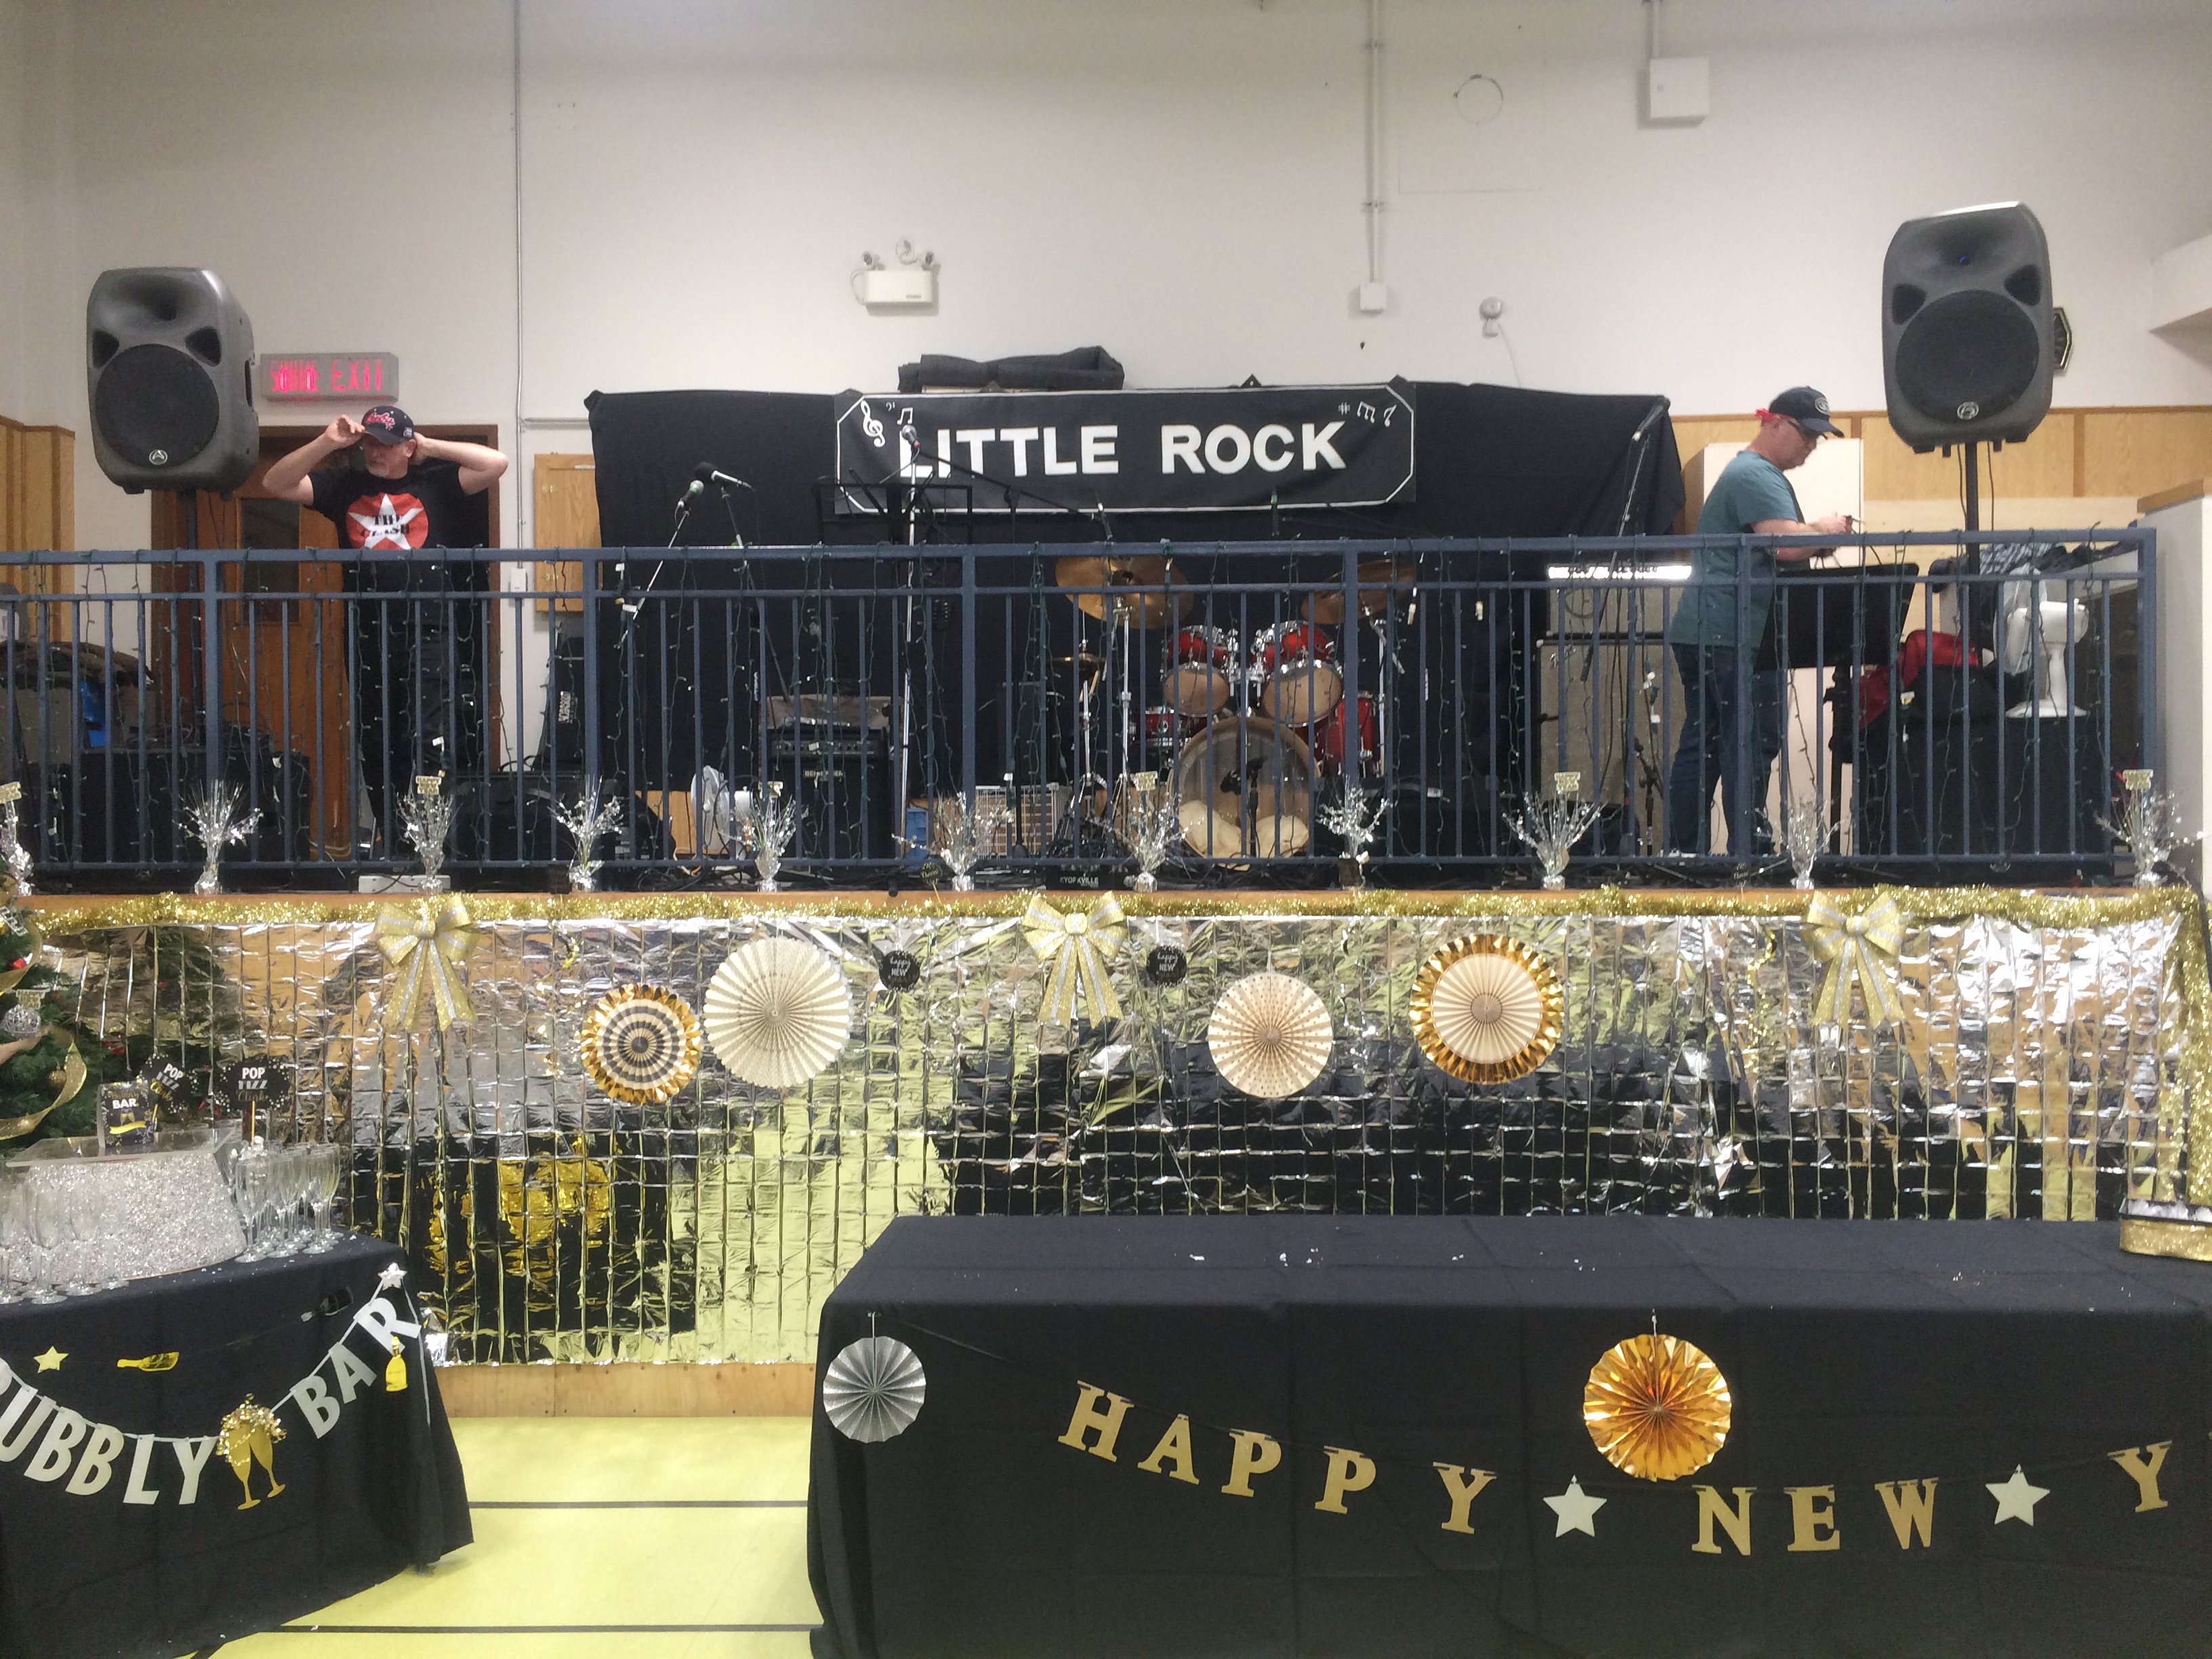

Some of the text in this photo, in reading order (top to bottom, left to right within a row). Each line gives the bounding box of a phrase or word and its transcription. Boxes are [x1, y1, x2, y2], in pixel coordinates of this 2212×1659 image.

[331, 357, 385, 392] EXIT
[899, 420, 1347, 478] LITTLE ROCK
[891, 967, 907, 977] NEW
[1159, 963, 1174, 972] NEW
[163, 1063, 184, 1080] POP
[242, 1067, 266, 1080] POP
[112, 1098, 137, 1109] BAR
[289, 1297, 422, 1439] BAR
[1057, 1380, 1497, 1534] HAPPY
[1692, 1477, 1939, 1555] NEW
